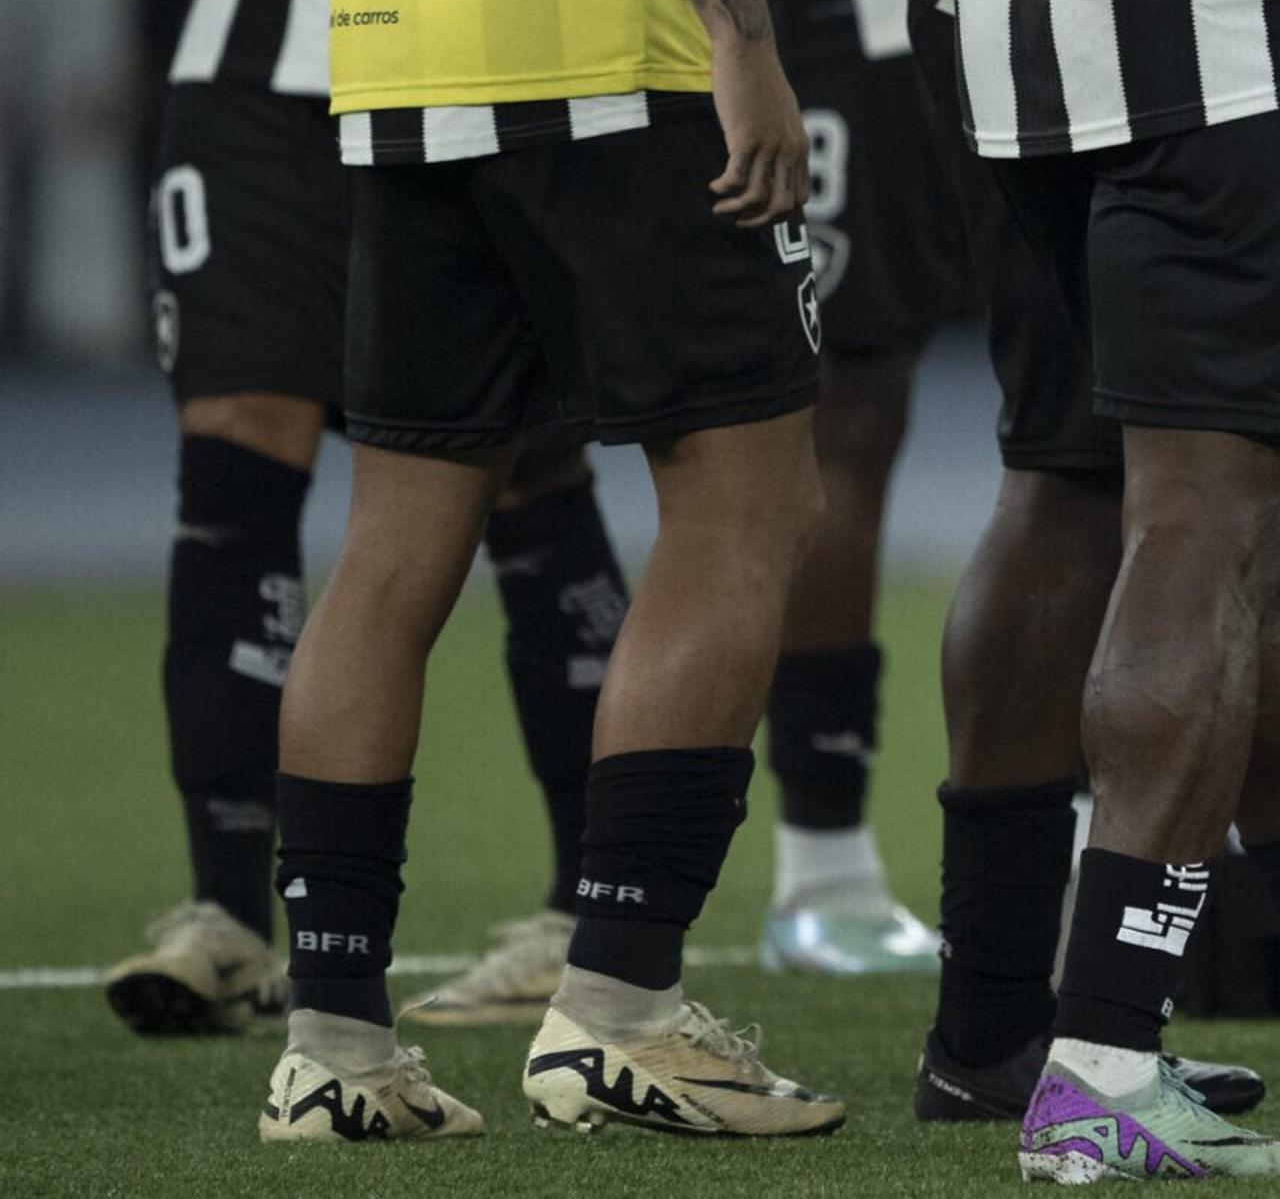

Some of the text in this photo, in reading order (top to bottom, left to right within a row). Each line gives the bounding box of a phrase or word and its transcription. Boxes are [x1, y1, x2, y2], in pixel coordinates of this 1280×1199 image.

[353, 9, 399, 27] carros
[157, 165, 212, 274] 0
[576, 878, 645, 905] BFR
[296, 930, 370, 955] BFR
